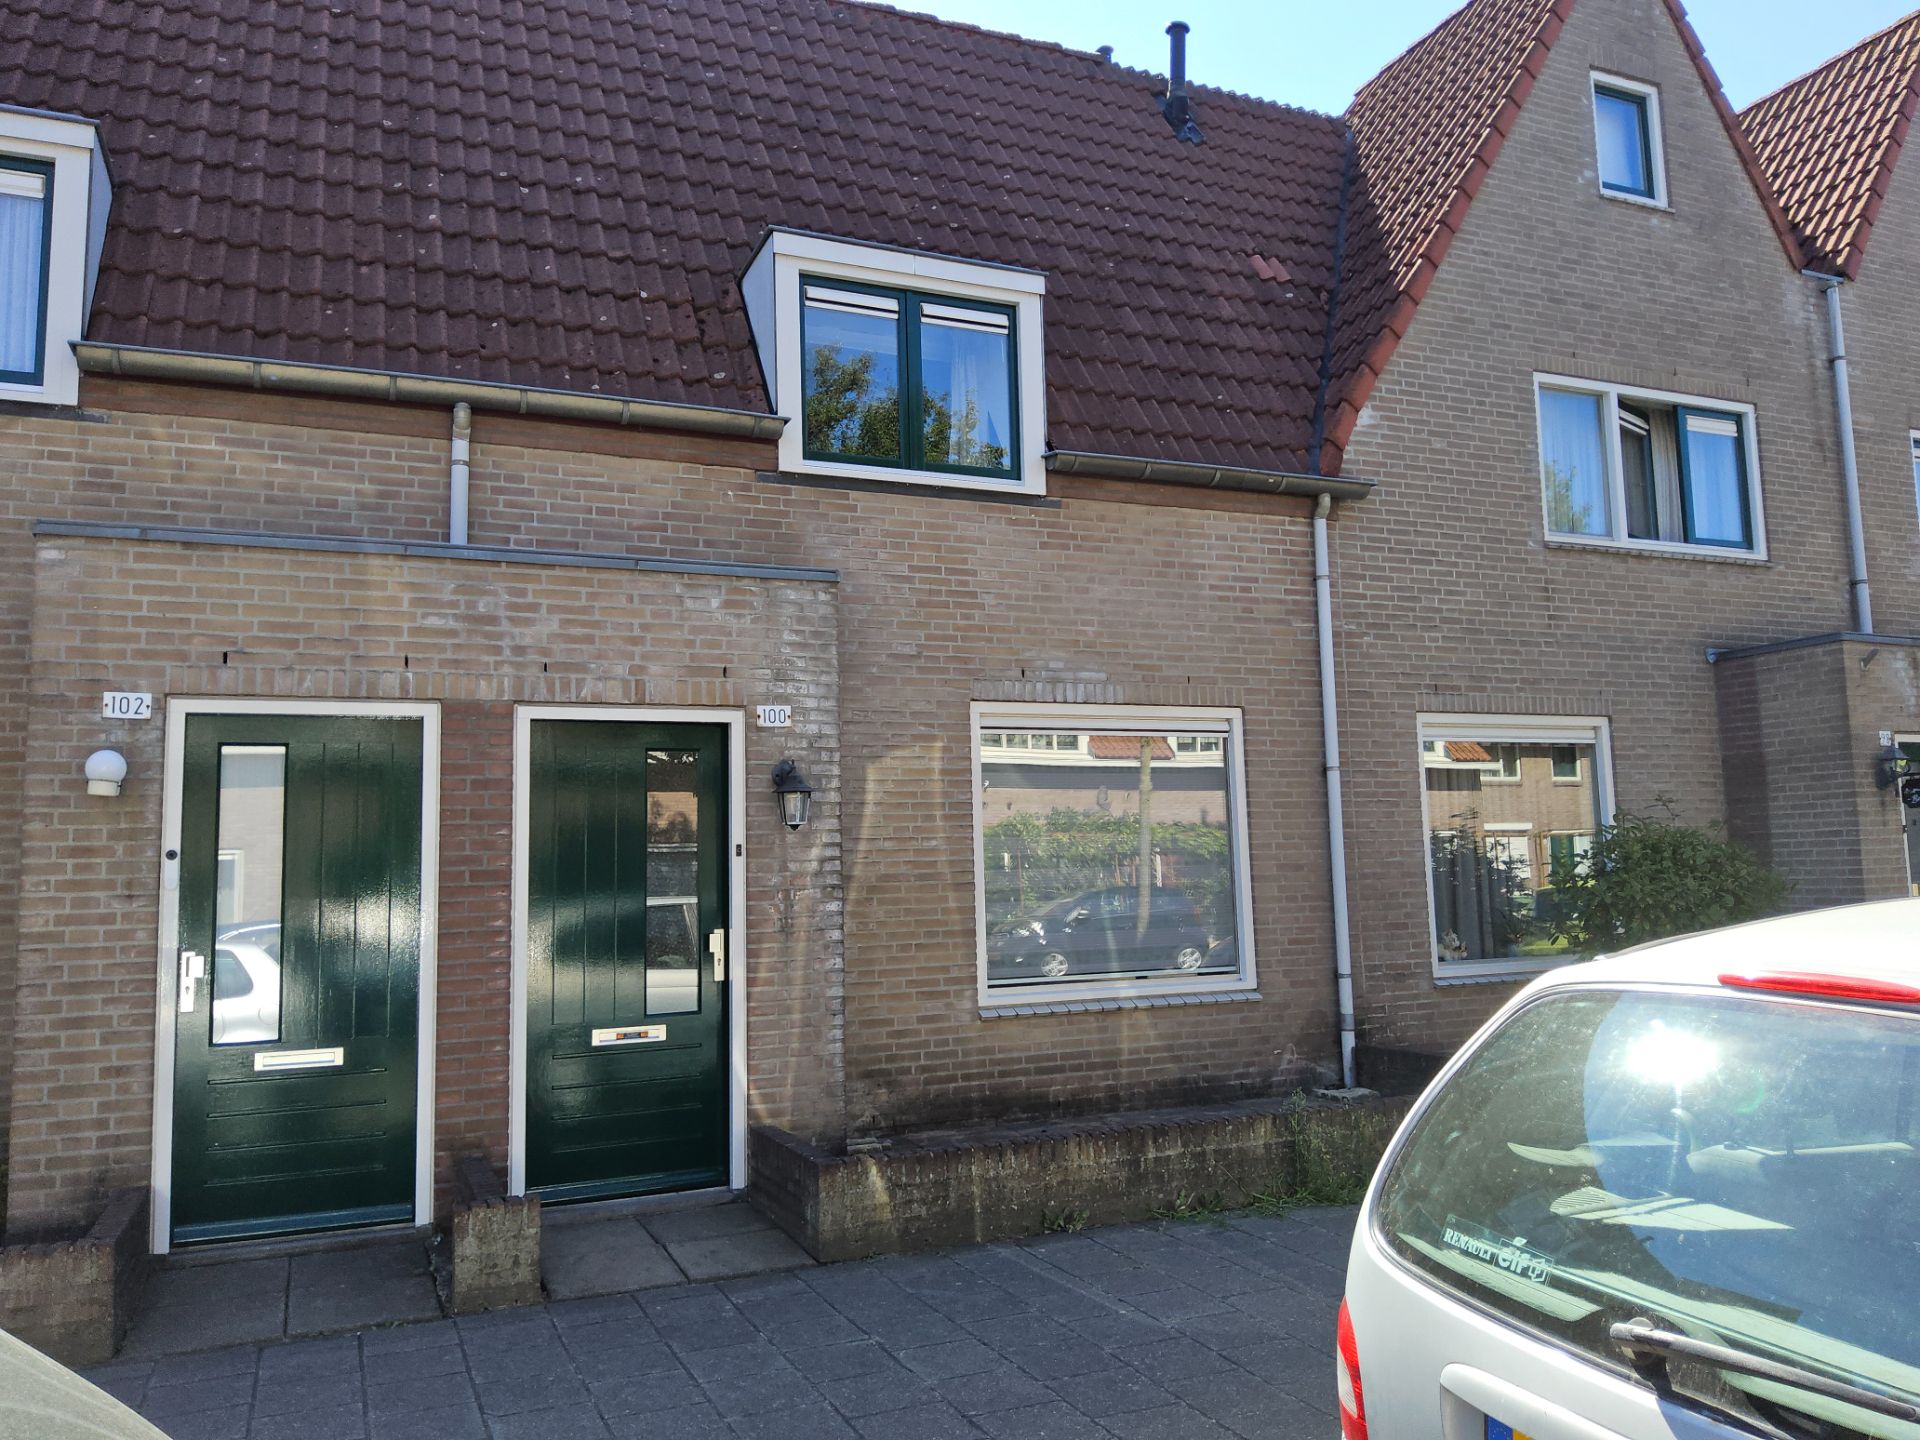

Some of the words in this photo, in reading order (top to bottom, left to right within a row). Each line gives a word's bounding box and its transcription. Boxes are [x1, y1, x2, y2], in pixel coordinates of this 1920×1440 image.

[112, 696, 144, 715] 102
[763, 708, 786, 724] 100
[1442, 1228, 1494, 1260] RENAULT
